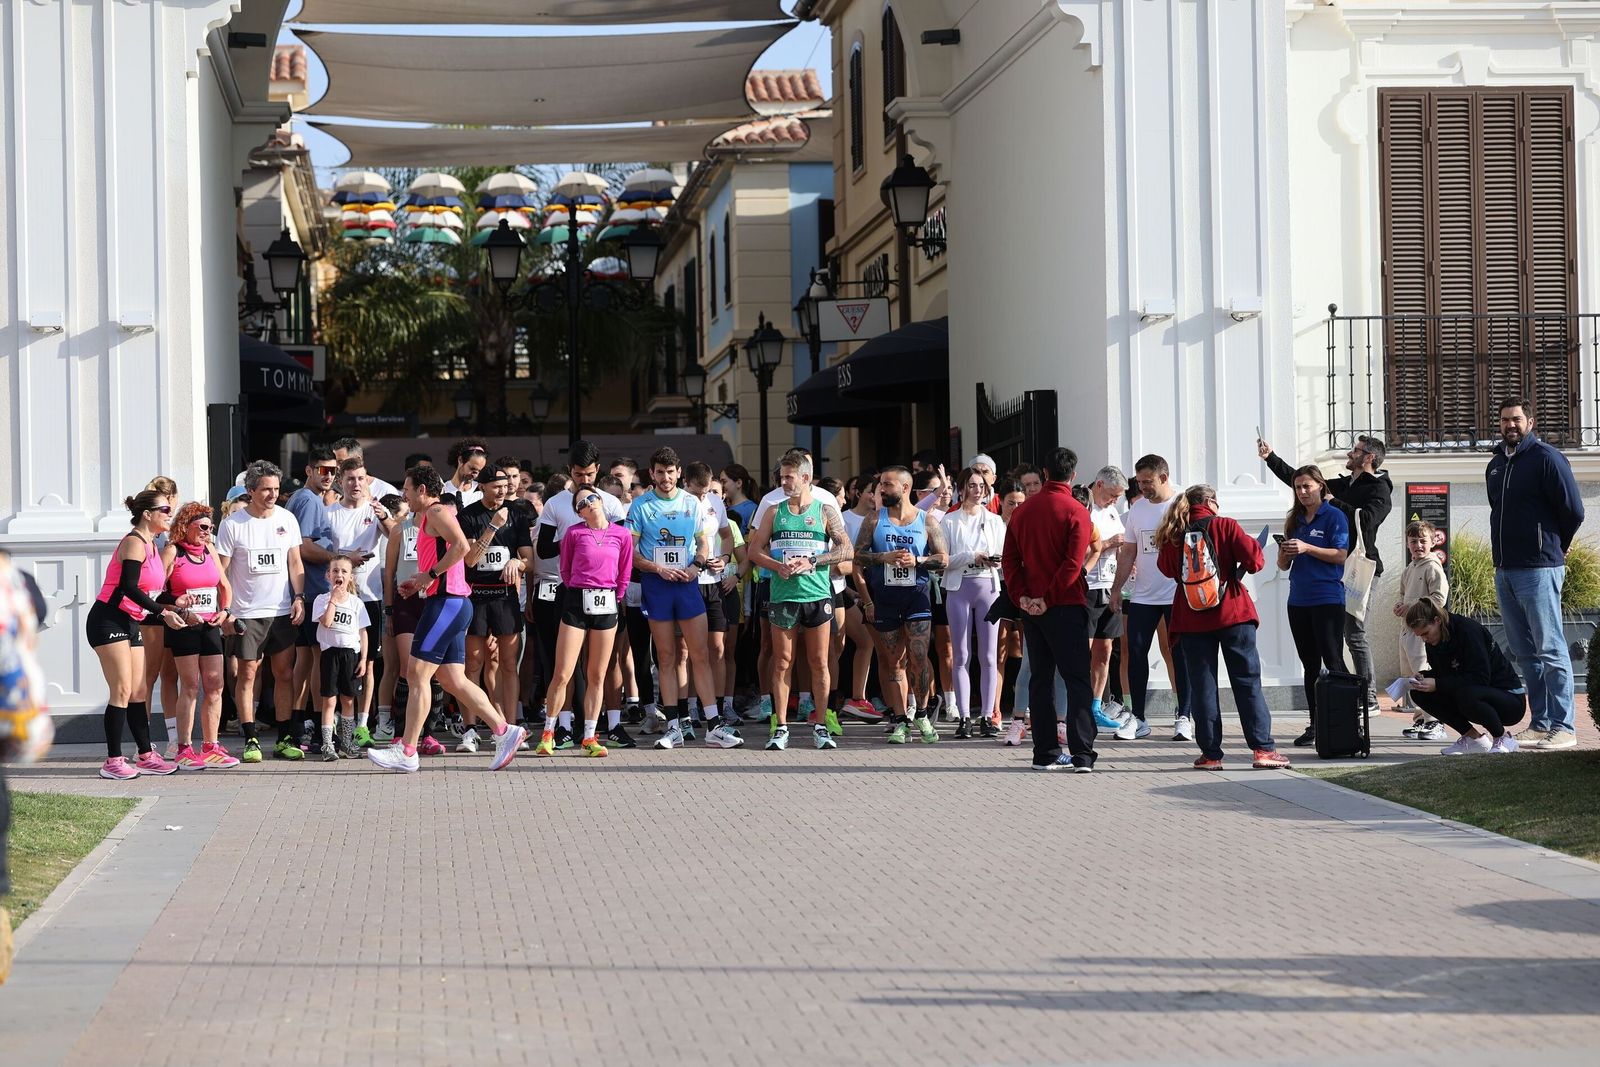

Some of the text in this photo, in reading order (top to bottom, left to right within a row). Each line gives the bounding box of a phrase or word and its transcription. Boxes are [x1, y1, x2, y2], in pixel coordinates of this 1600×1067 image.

[356, 415, 405, 423] Guest Services
[780, 531, 814, 539] ATLETISMO
[885, 534, 914, 545] ERESO
[257, 553, 275, 565] 501
[485, 552, 502, 564] 108
[663, 552, 679, 563] 161
[892, 567, 909, 579] 169
[594, 595, 606, 607] 84
[333, 611, 352, 626] 503
